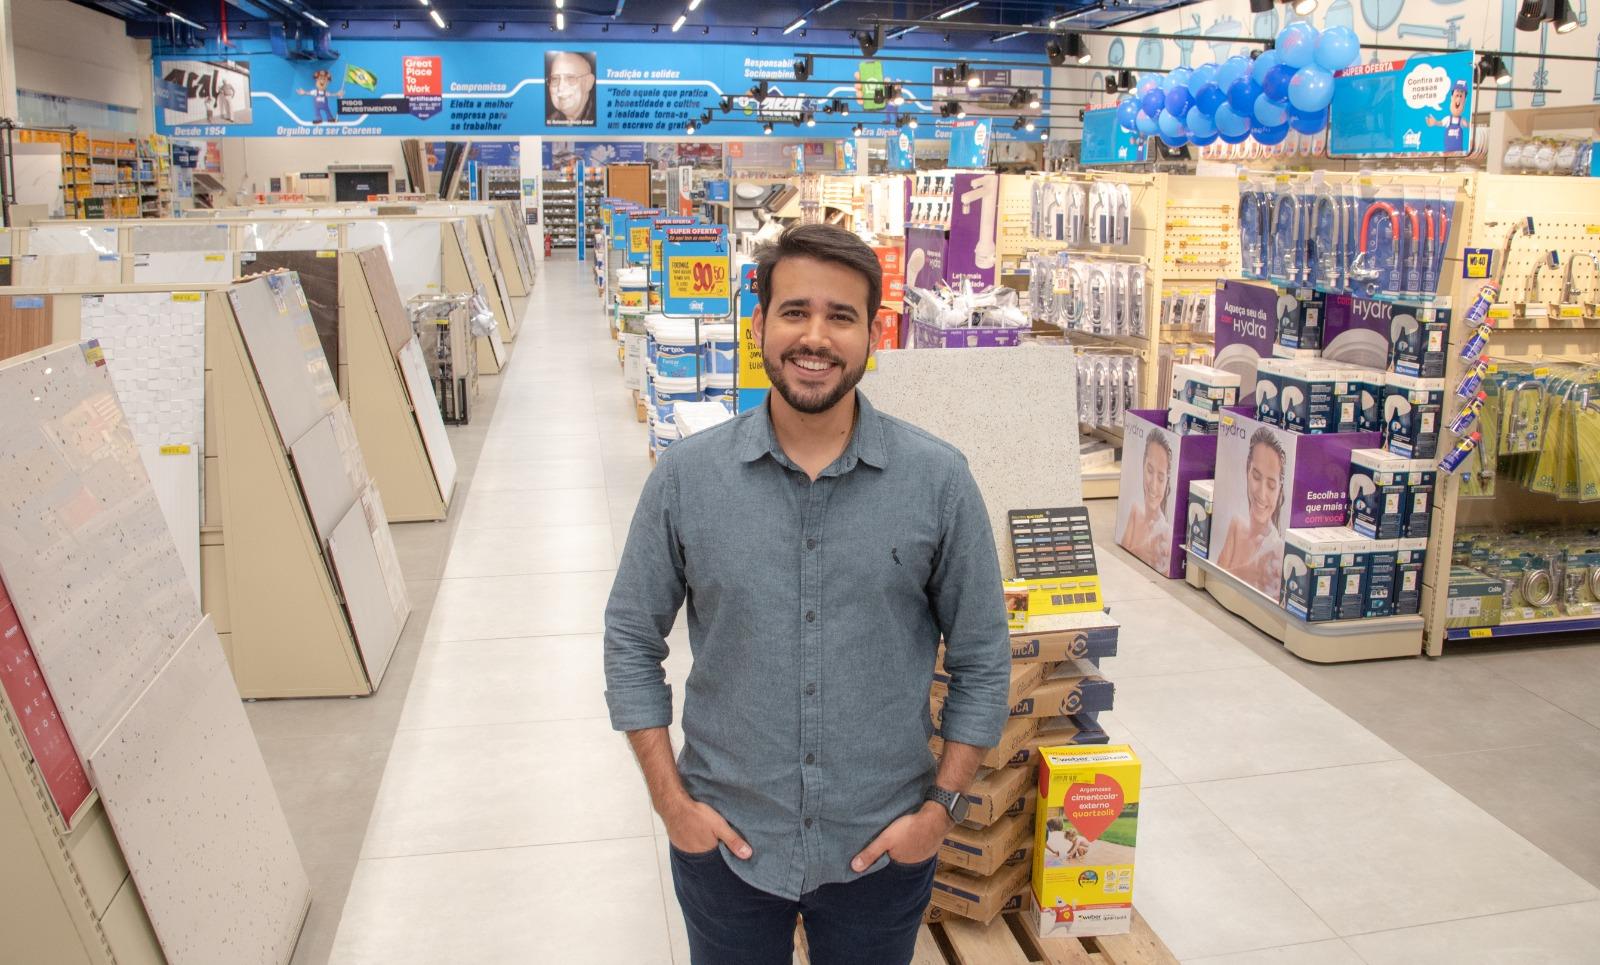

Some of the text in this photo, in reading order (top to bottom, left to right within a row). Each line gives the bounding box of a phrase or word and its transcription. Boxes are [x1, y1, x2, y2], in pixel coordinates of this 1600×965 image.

[405, 59, 432, 68] Great
[1342, 62, 1393, 77] SUPER OFERTA
[607, 70, 642, 80] Tradição
[651, 70, 680, 79] solidez
[1408, 78, 1433, 87] Confira
[406, 85, 430, 93] Work
[450, 82, 507, 93] Compromisso
[633, 89, 661, 99] aquele
[663, 91, 677, 100] que
[679, 88, 709, 99] pratica
[1412, 92, 1437, 100] ofertas
[450, 100, 475, 108] Eleita
[484, 100, 513, 108] melhor
[450, 112, 508, 121] empresa para
[614, 111, 650, 119] lealdade
[655, 110, 688, 119] torna-se
[174, 126, 226, 135] Desde 1954
[463, 122, 502, 130] trabalhar
[623, 121, 654, 129] escravo
[656, 121, 667, 129] da
[668, 121, 702, 131] gratio
[277, 127, 310, 137] Orgulho
[312, 127, 323, 135] de
[341, 126, 382, 135] Cearense
[862, 128, 878, 136] Era
[935, 130, 952, 139] Cons
[1224, 302, 1267, 320] Aqueça seu dia
[1233, 318, 1267, 339] Hydra
[659, 344, 686, 354] fortex
[1307, 490, 1339, 500] Escolha
[1306, 504, 1322, 513] que
[1322, 501, 1343, 511] mais
[1305, 512, 1344, 524] com você
[1488, 584, 1502, 593] Celite
[1079, 802, 1110, 810] externo
[1072, 809, 1115, 819] quartzolit
